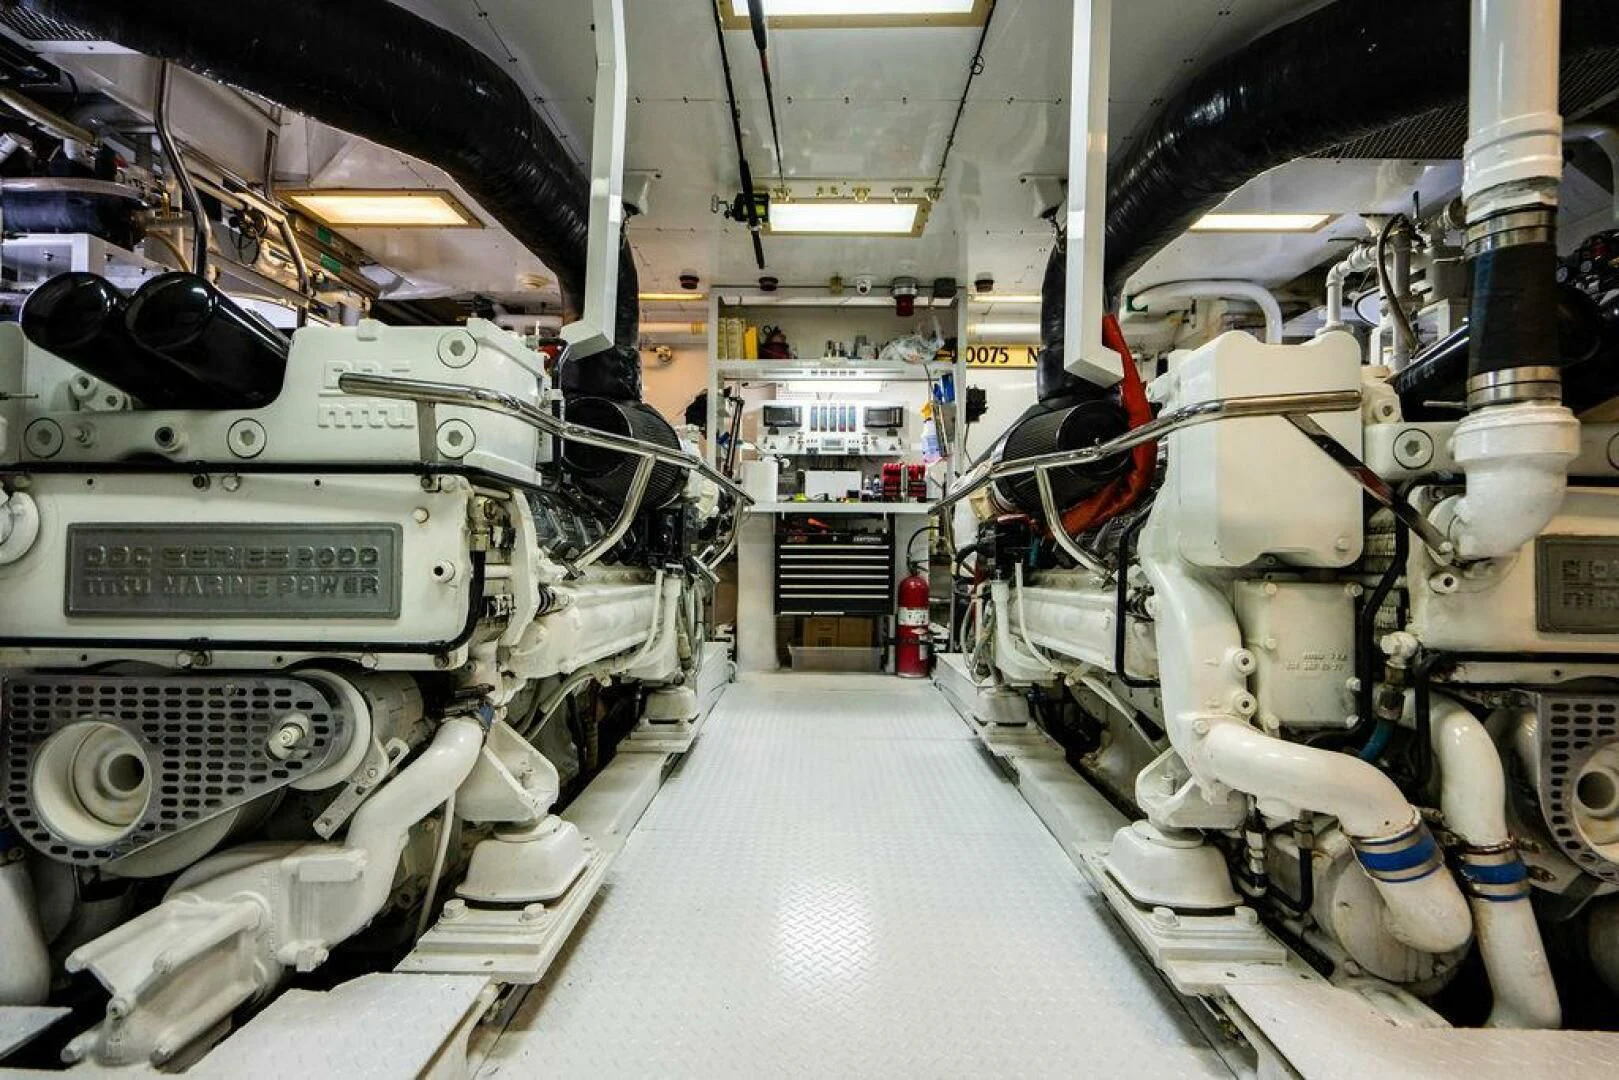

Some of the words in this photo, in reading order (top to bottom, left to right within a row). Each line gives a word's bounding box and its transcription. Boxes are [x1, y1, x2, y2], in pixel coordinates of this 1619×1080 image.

[161, 544, 291, 569] SERIES
[161, 574, 272, 597] MARINE
[277, 574, 380, 597] POWER
